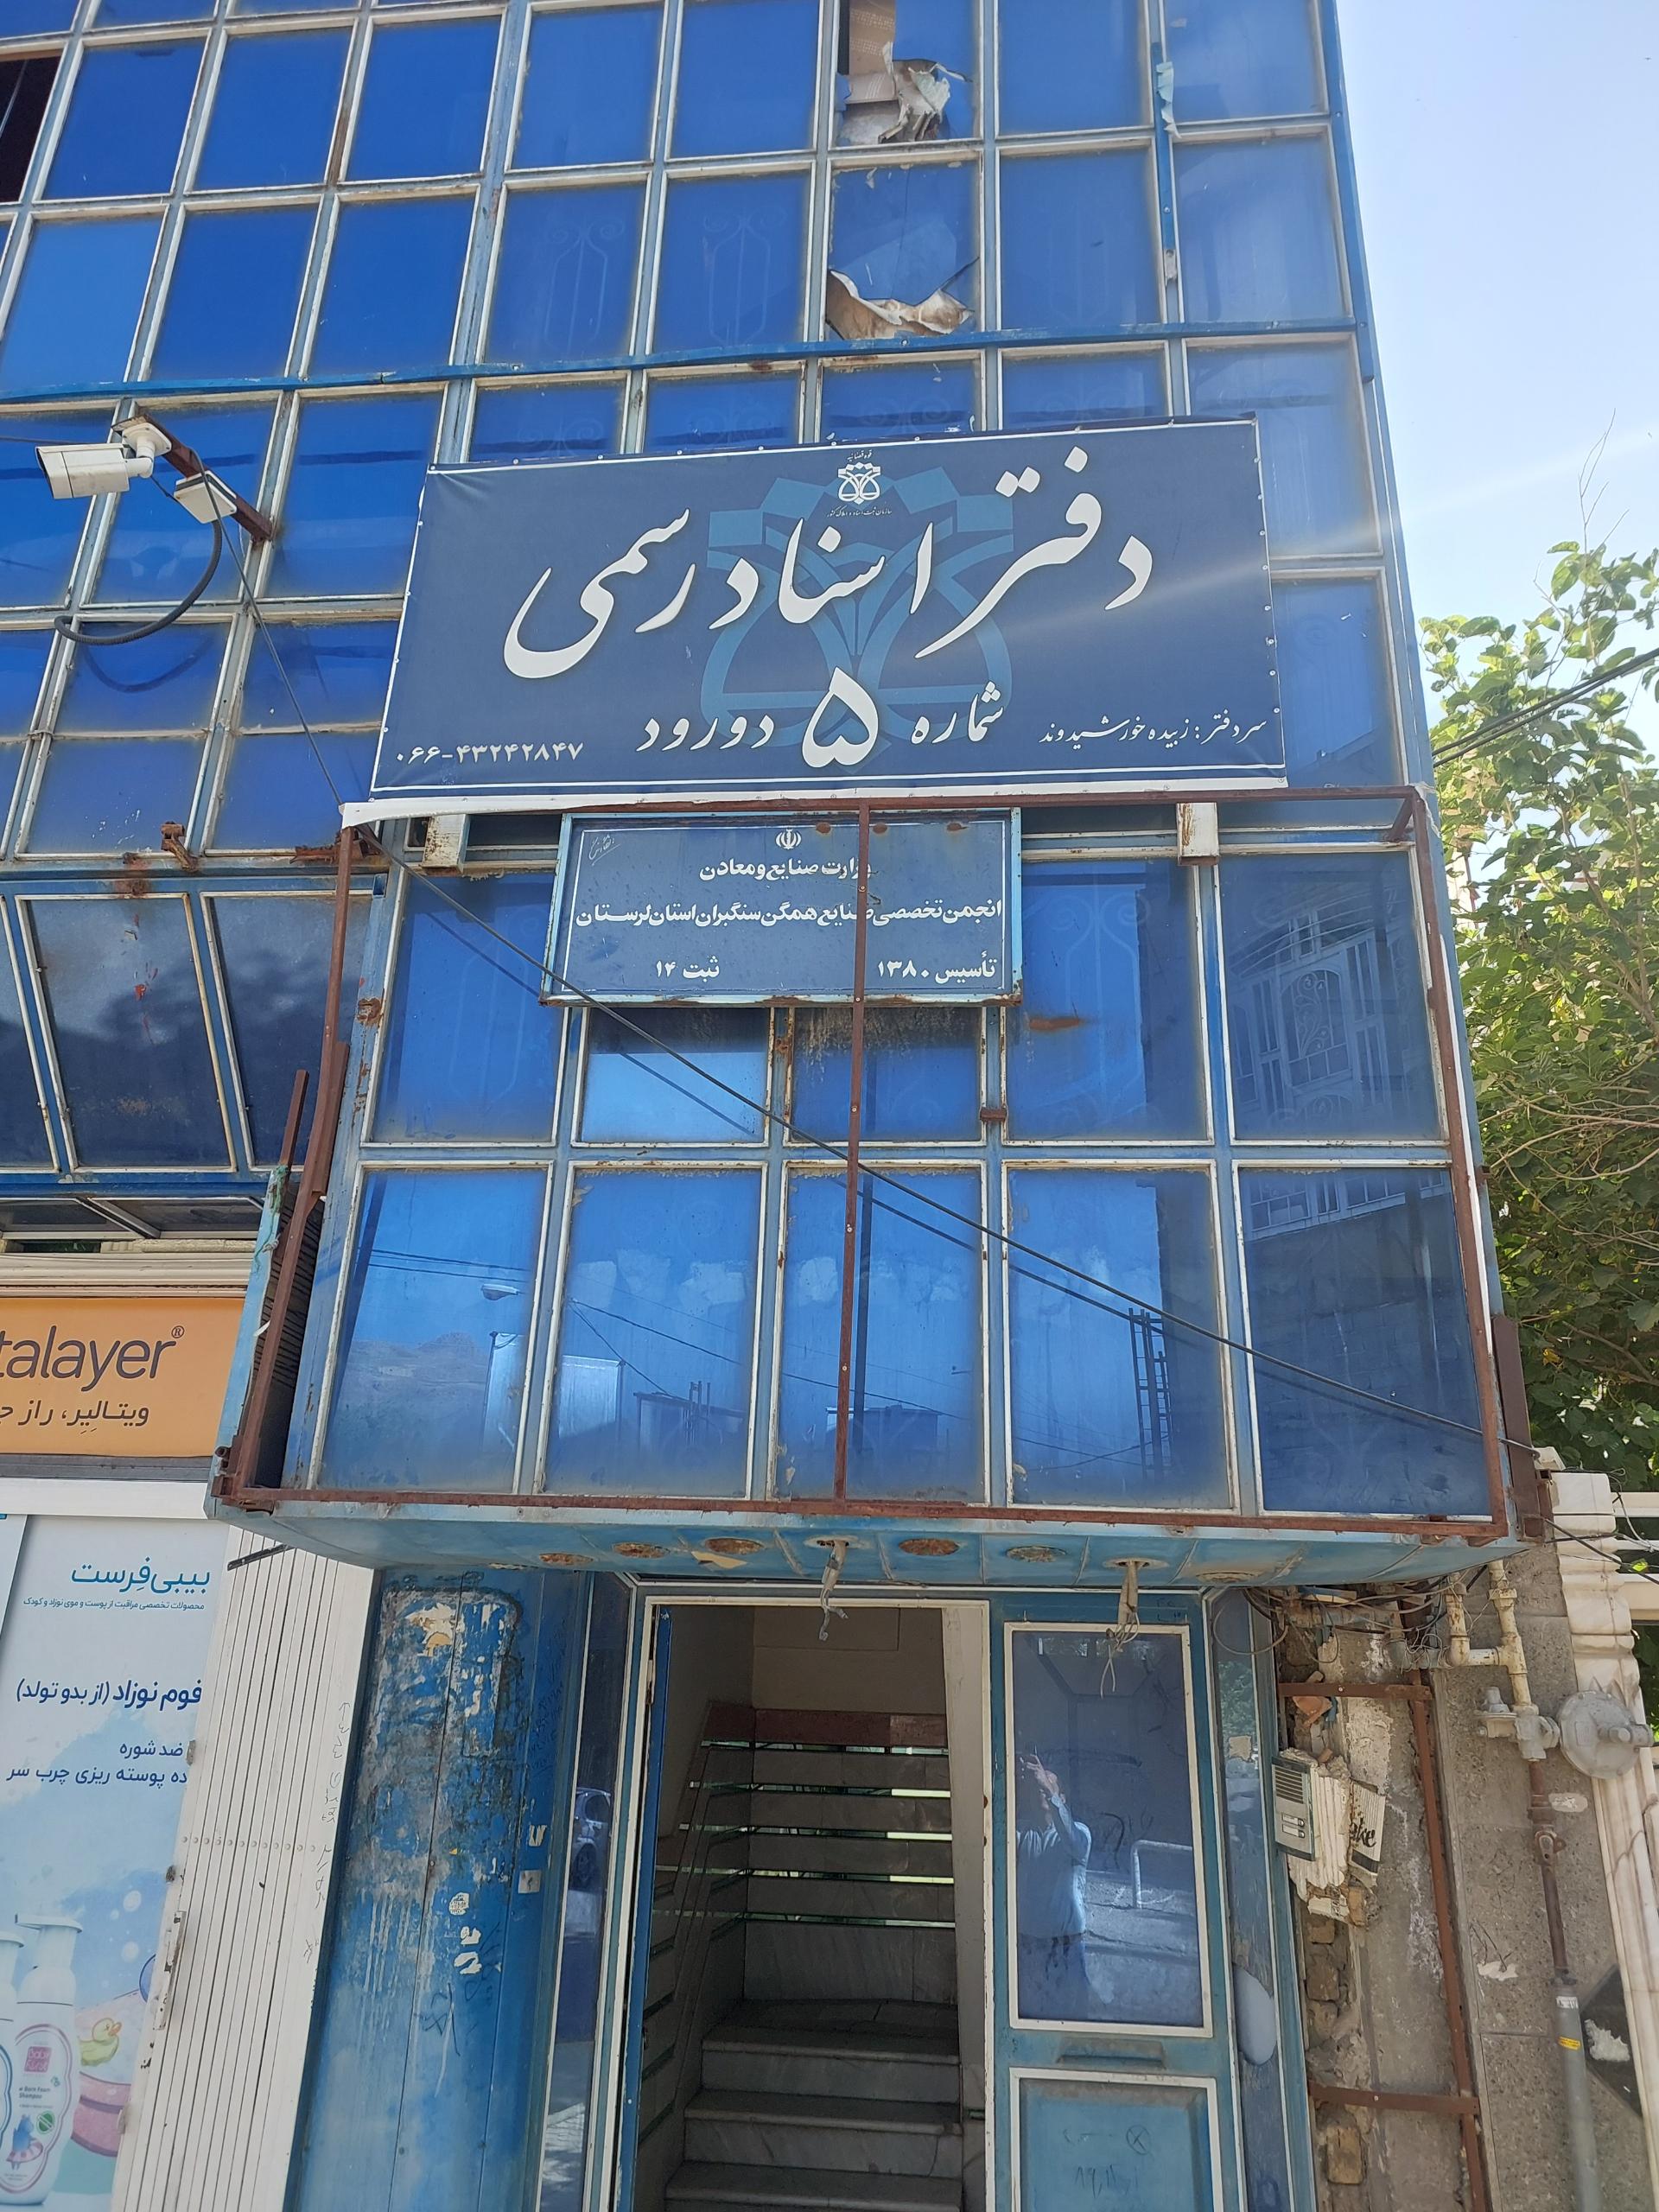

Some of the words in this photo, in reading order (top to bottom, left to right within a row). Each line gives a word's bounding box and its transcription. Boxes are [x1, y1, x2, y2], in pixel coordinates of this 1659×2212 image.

[914, 446, 1154, 659] دفتر
[709, 518, 934, 630] اسناد
[503, 508, 696, 678] رسمی
[802, 666, 880, 768] ۵
[910, 681, 1006, 746] شماره
[635, 715, 775, 752] دورود
[1038, 715, 1147, 750] خورشیدوند
[1147, 718, 1191, 749] زبیده
[396, 741, 584, 765] ۰۶۶-۴۳۲۴۲۸۴۷
[698, 857, 755, 881] معادن
[754, 864, 766, 880] و
[766, 856, 819, 880] صنایع
[575, 904, 652, 927] لرستان
[648, 903, 696, 927] استان
[695, 902, 761, 927] سنگبران
[760, 901, 817, 927] همگن
[872, 899, 944, 926] تخصصی
[942, 899, 1002, 925] انجمن
[656, 960, 677, 978] ۱۴
[682, 955, 721, 982] ثبت
[878, 959, 931, 978] ۱۳۸۰
[935, 950, 997, 984] تأسیس
[17, 1399, 54, 1426] راز
[23, 1597, 44, 1607] کودک
[48, 1598, 63, 1608] نوزاد
[114, 1599, 138, 1611] مراقبت
[138, 1601, 170, 1611] تخصصی
[170, 1601, 205, 1611] محصولات
[60, 1684, 88, 1705] بدو
[112, 1679, 158, 1709] نوزاد
[159, 1679, 203, 1711] فوم
[119, 1740, 156, 1759] شوره
[158, 1742, 184, 1758] ضد
[6, 1768, 30, 1781] سر
[35, 1767, 70, 1785] چرب
[75, 1767, 111, 1784] ریزی
[116, 1768, 165, 1789] پوسته
